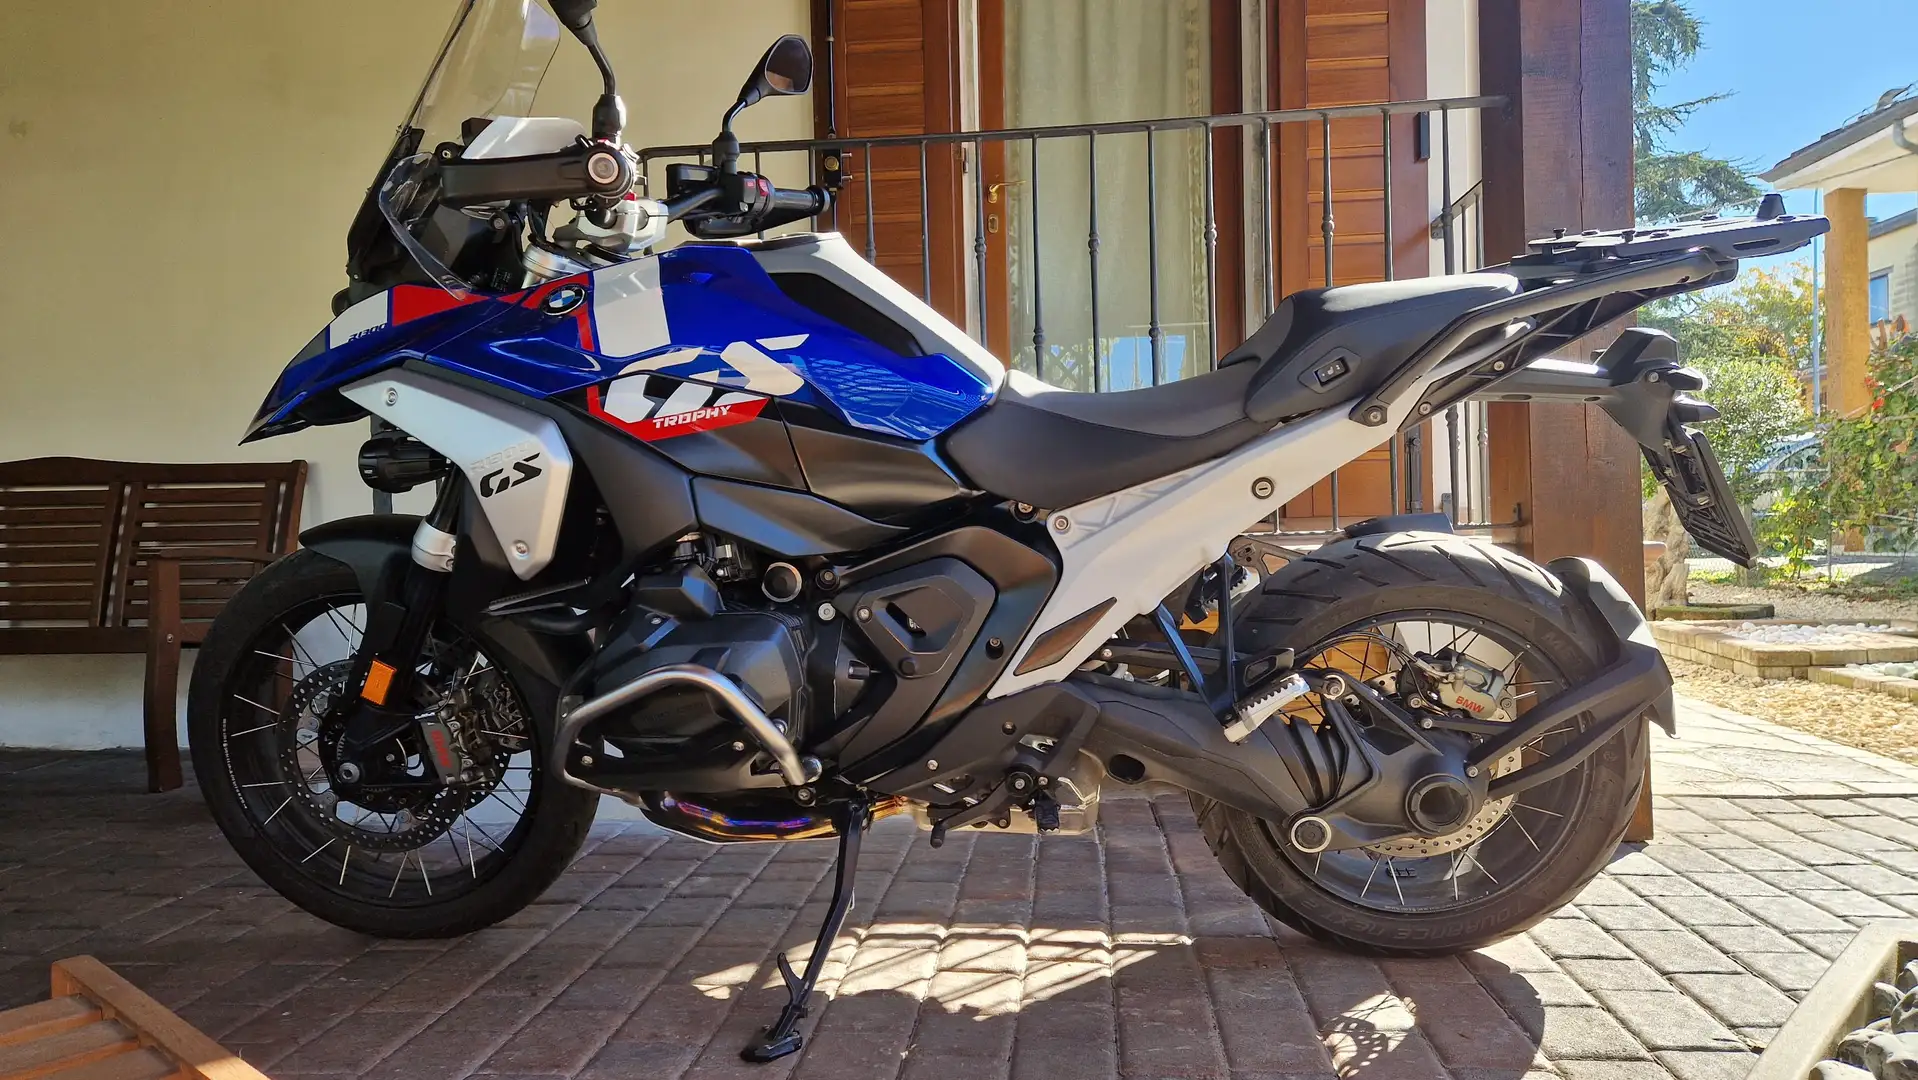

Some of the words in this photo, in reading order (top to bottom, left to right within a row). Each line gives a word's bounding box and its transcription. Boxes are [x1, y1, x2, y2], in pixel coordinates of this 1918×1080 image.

[652, 405, 732, 429] TROPHY
[480, 452, 543, 498] GS
[1455, 695, 1485, 713] BMW
